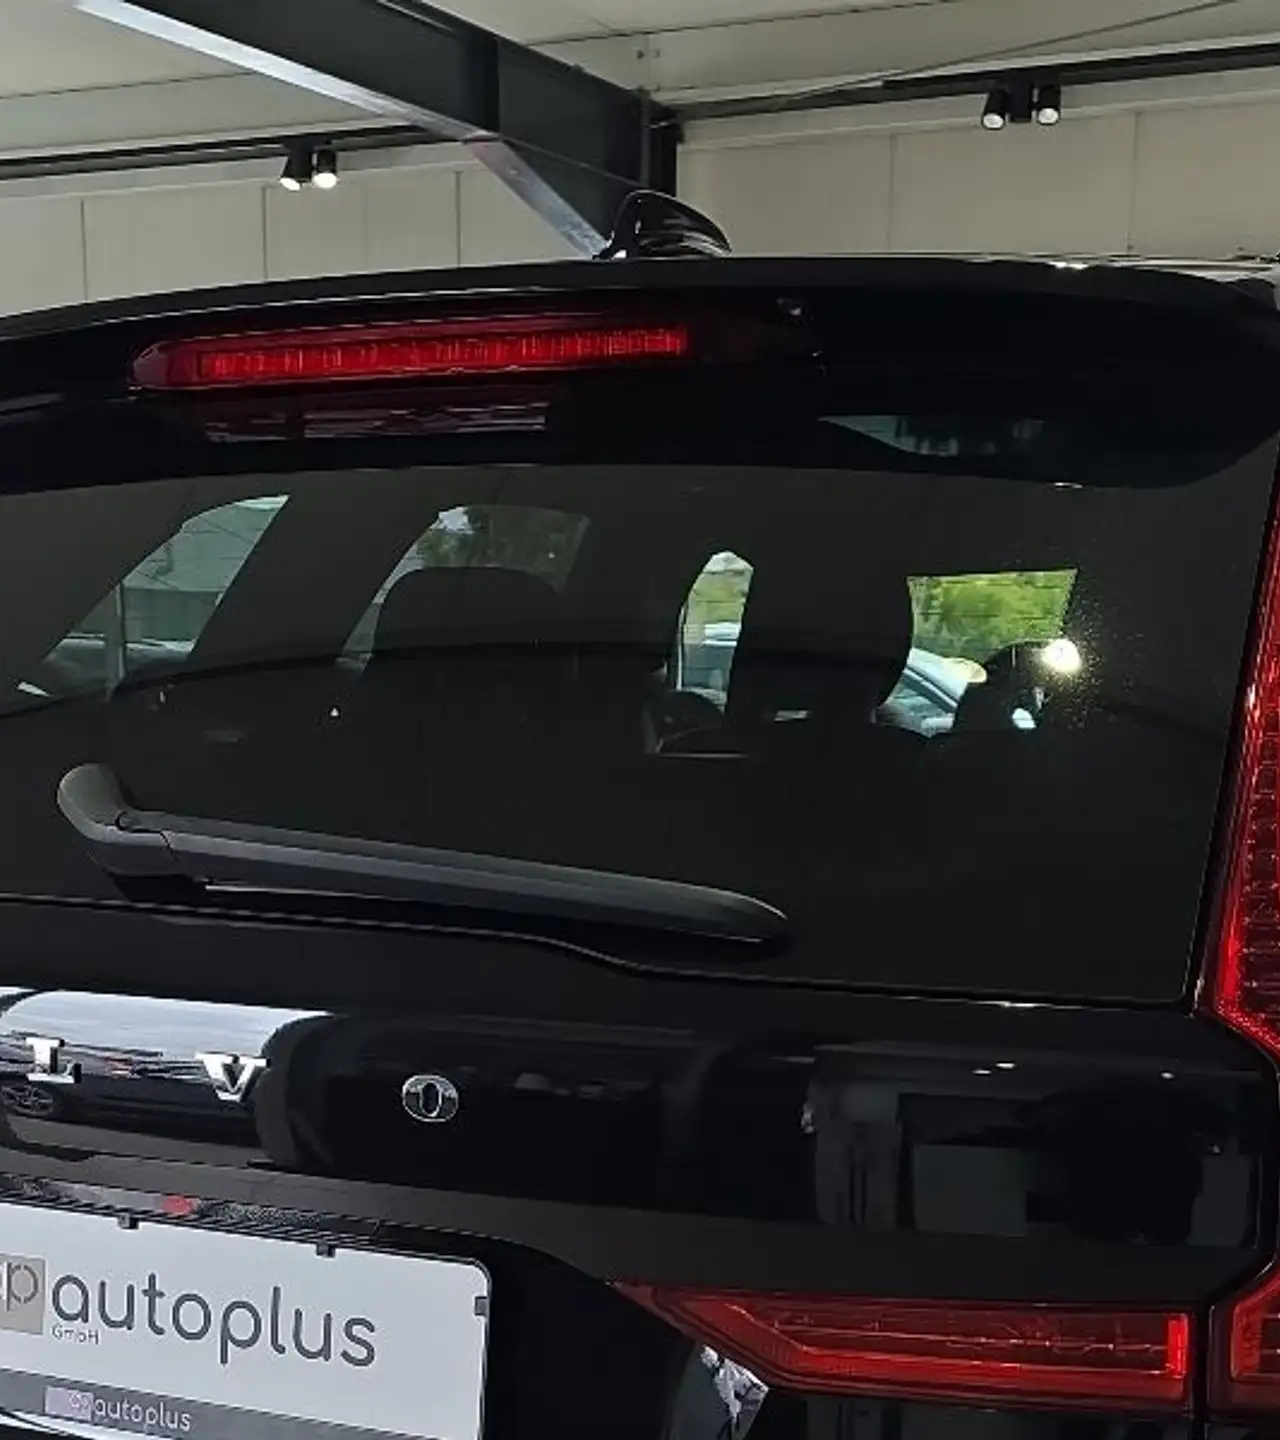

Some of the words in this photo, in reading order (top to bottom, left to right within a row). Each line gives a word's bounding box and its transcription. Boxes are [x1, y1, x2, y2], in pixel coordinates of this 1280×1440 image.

[51, 1272, 377, 1367] autoplus
[51, 1324, 100, 1345] GmbH
[94, 1397, 193, 1434] autoplus
